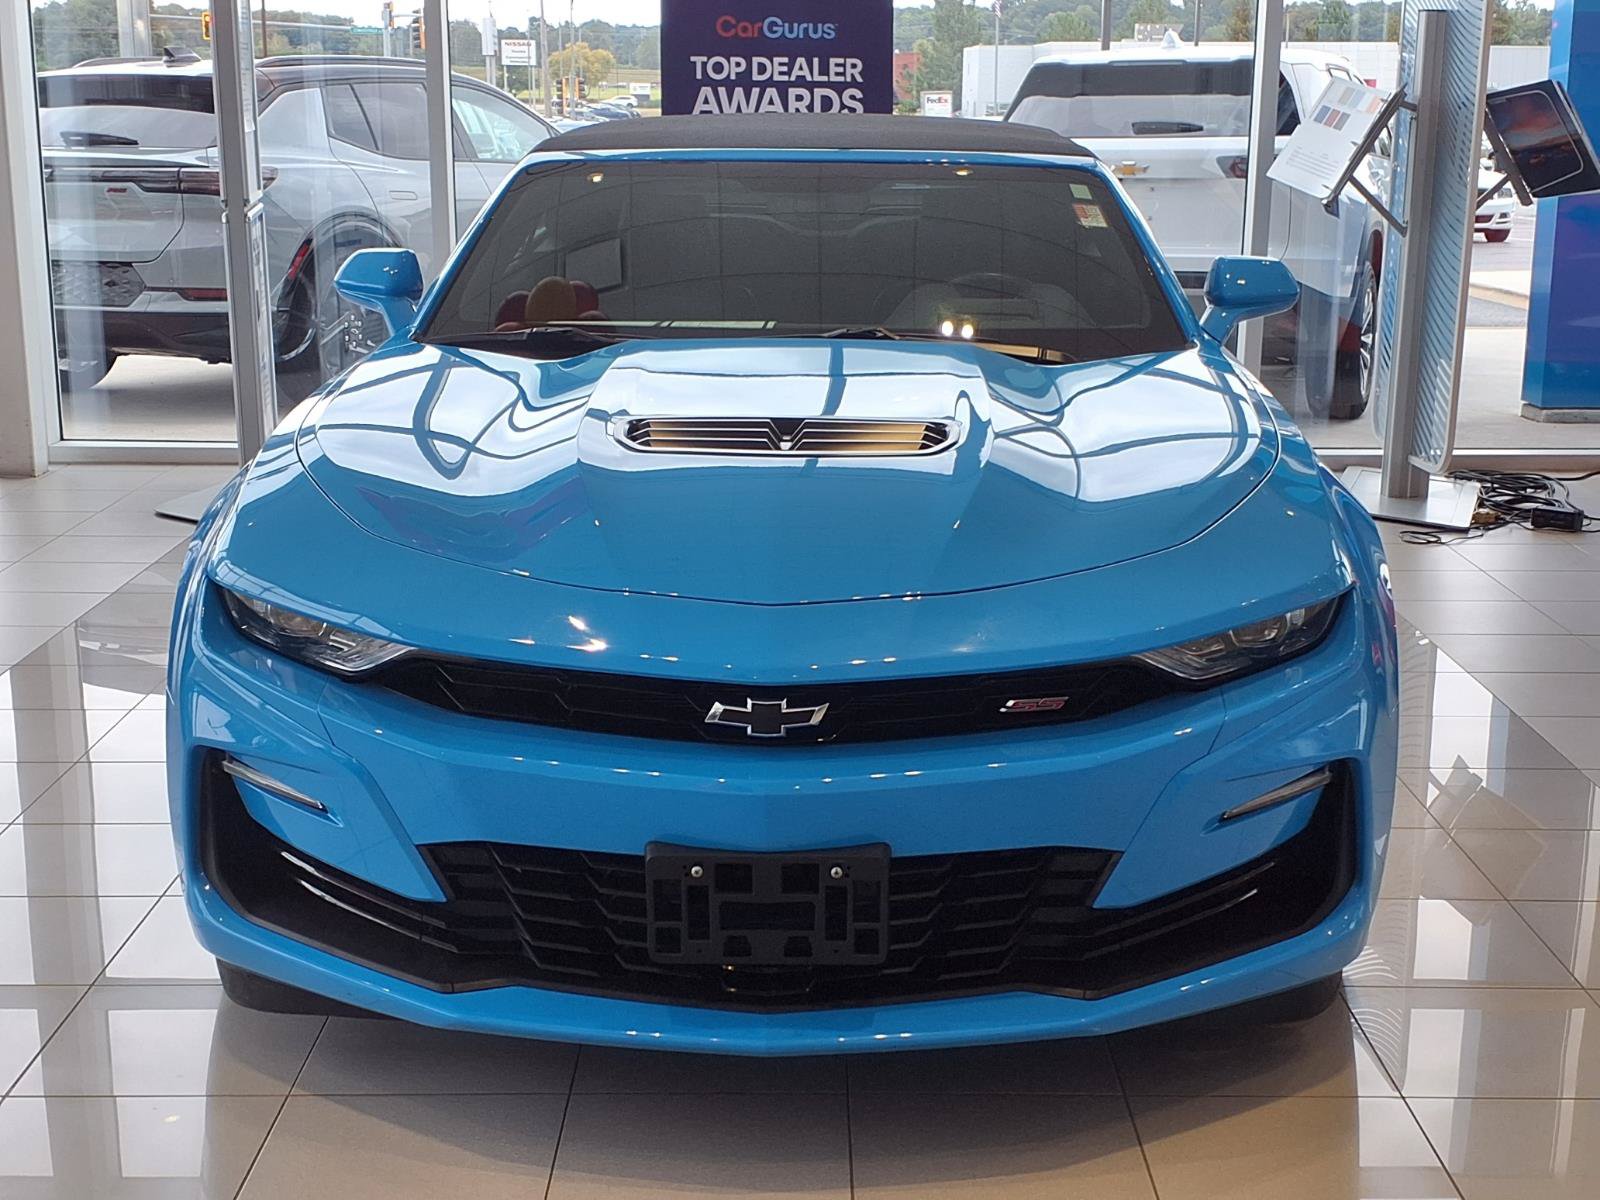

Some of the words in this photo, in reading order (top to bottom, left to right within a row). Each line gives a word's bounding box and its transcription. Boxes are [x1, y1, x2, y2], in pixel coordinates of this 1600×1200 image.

[690, 55, 746, 80] TOP
[751, 56, 864, 83] DEALER
[692, 86, 864, 115] AWARDS
[1000, 697, 1069, 713] SS
